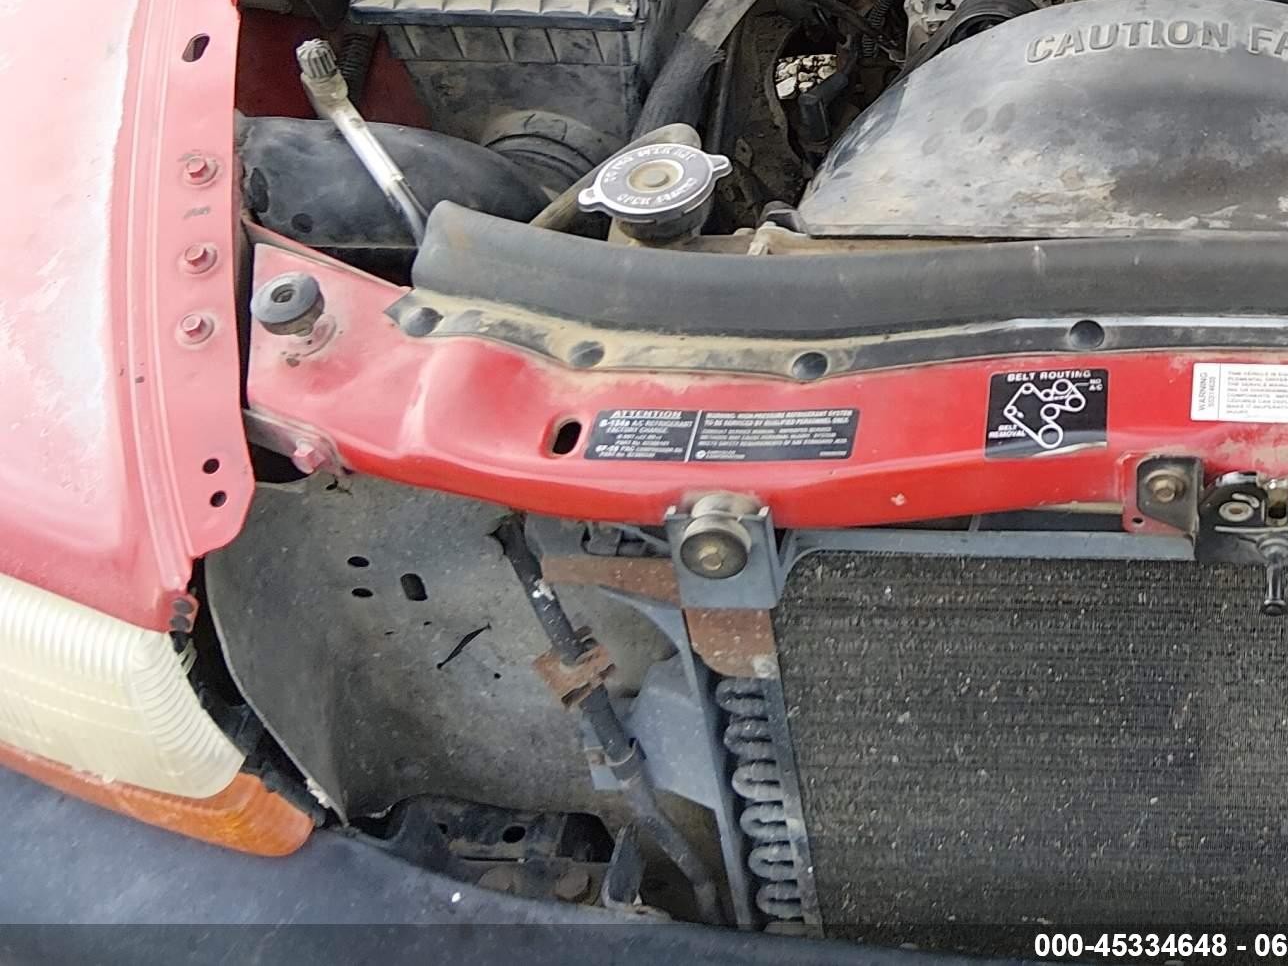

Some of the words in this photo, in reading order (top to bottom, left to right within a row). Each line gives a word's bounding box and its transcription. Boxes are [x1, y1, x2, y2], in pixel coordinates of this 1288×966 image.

[1024, 19, 1230, 64] CAUTION
[1007, 372, 1036, 382] BELT
[1040, 370, 1092, 380] ROUTING
[609, 410, 682, 419] ATTENTION
